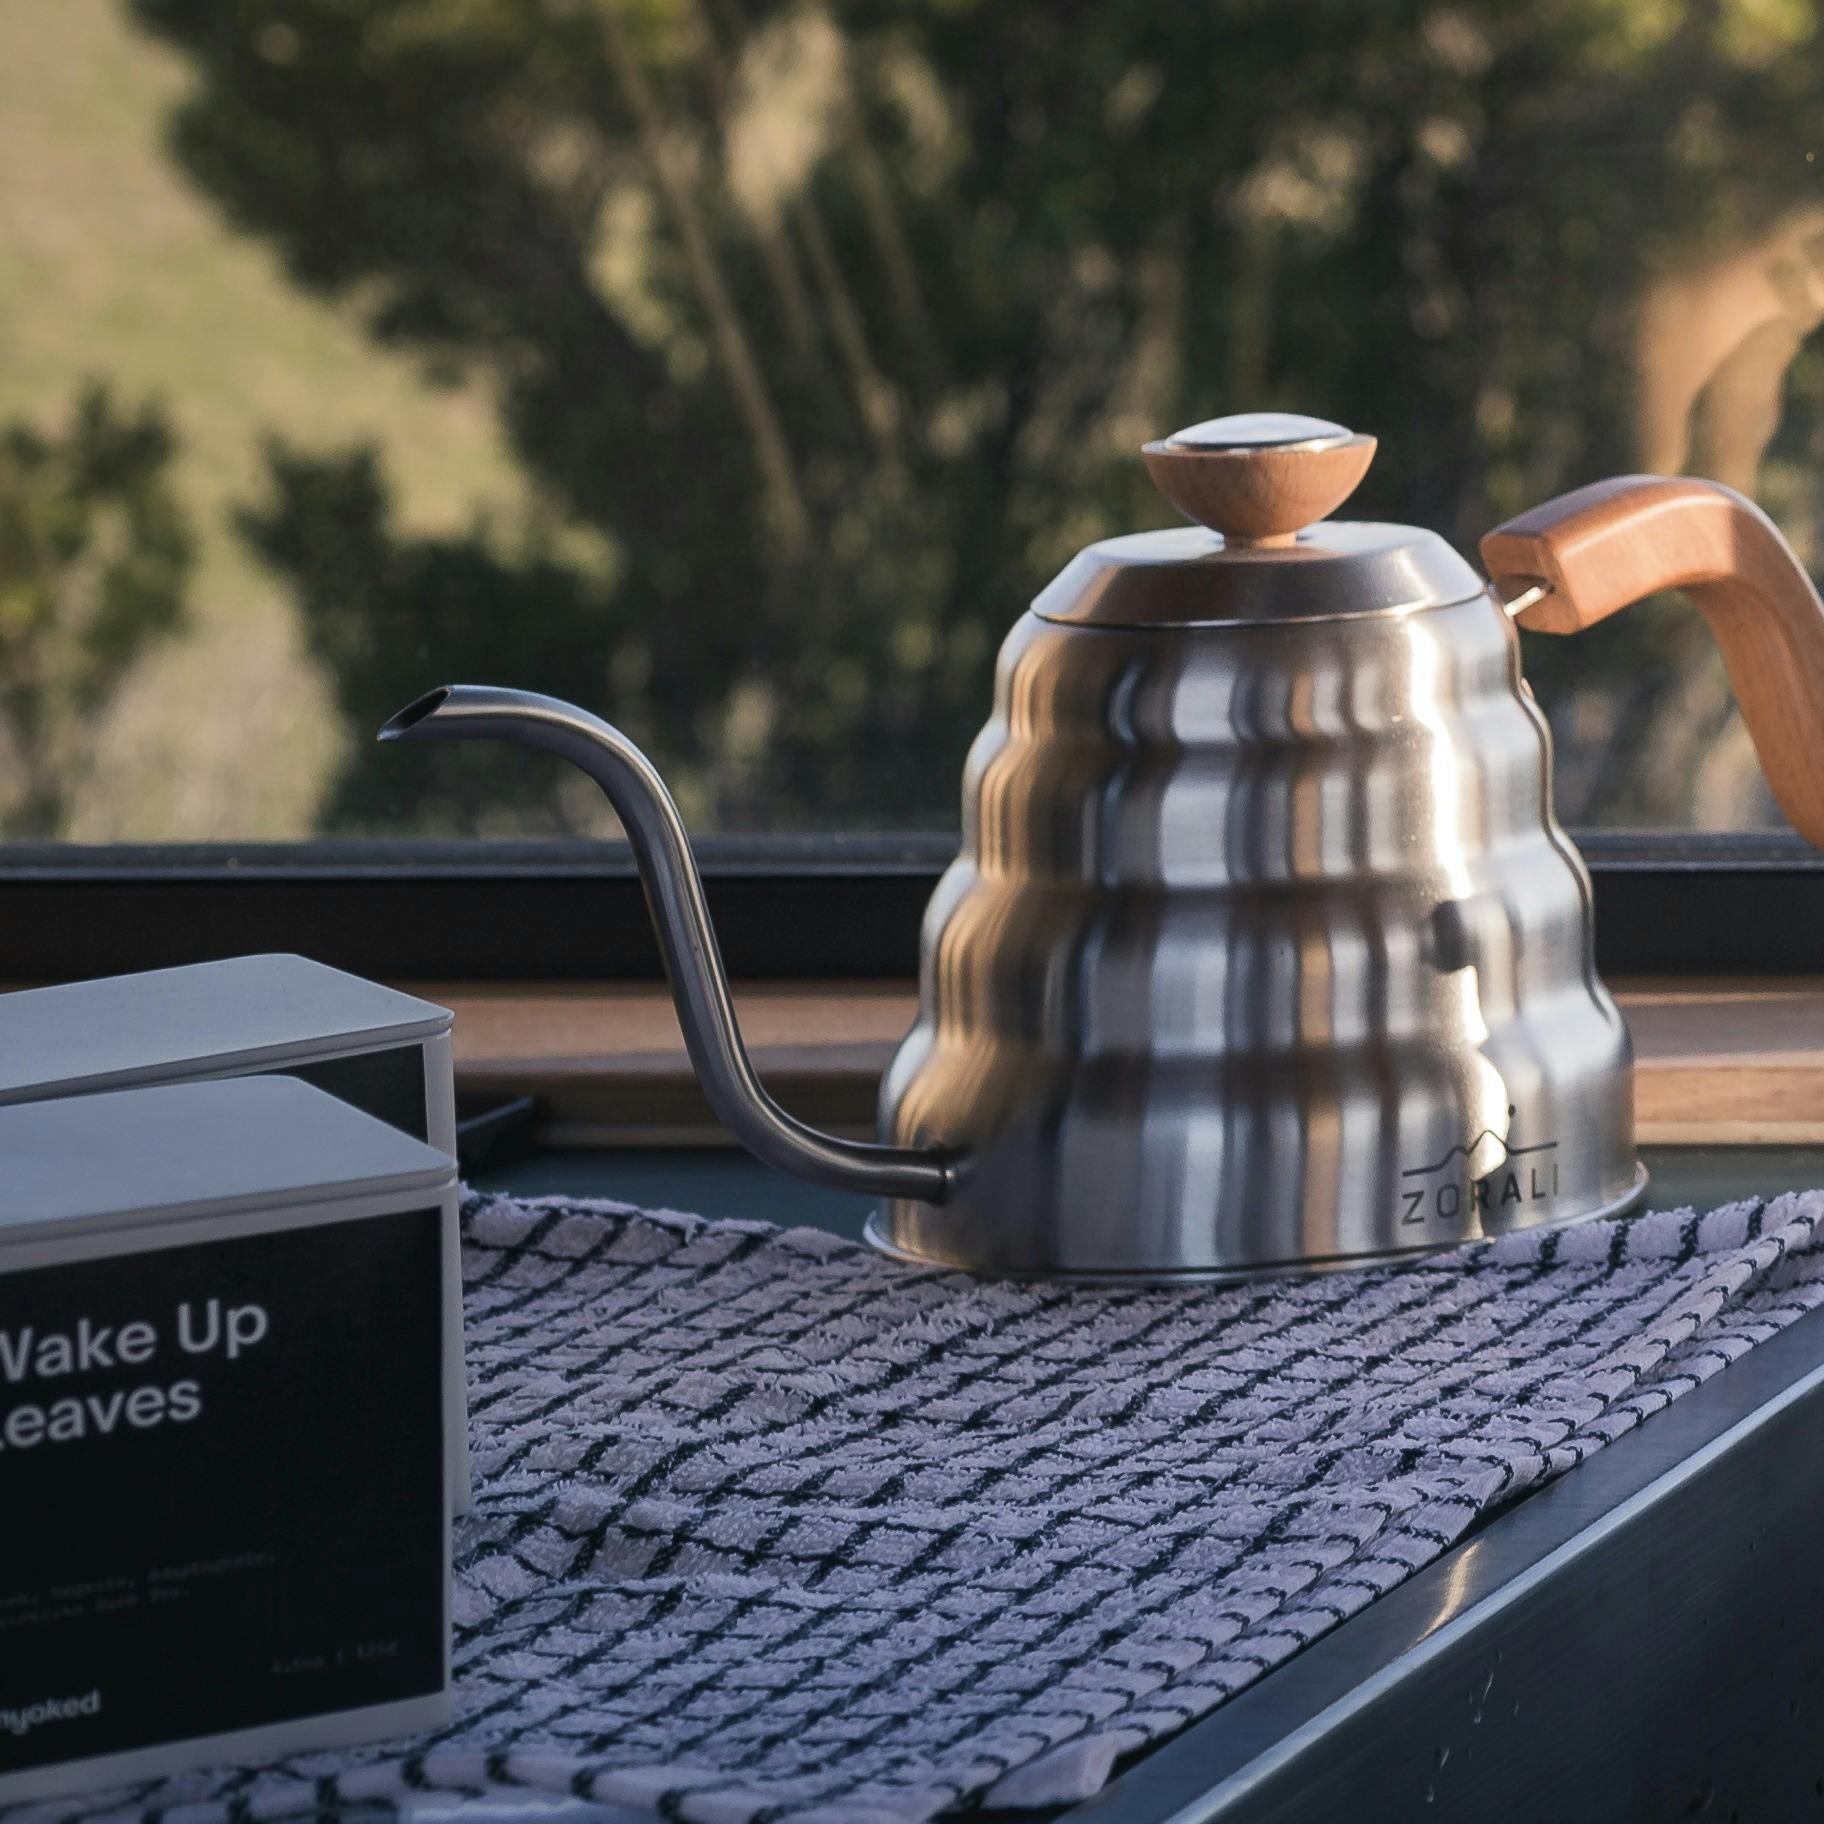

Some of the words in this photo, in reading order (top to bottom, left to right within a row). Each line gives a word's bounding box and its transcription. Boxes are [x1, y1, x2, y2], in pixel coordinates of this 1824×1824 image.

[1400, 1164, 1560, 1226] ZORALI
[177, 1298, 269, 1359] Up
[0, 1378, 203, 1450] eaves
